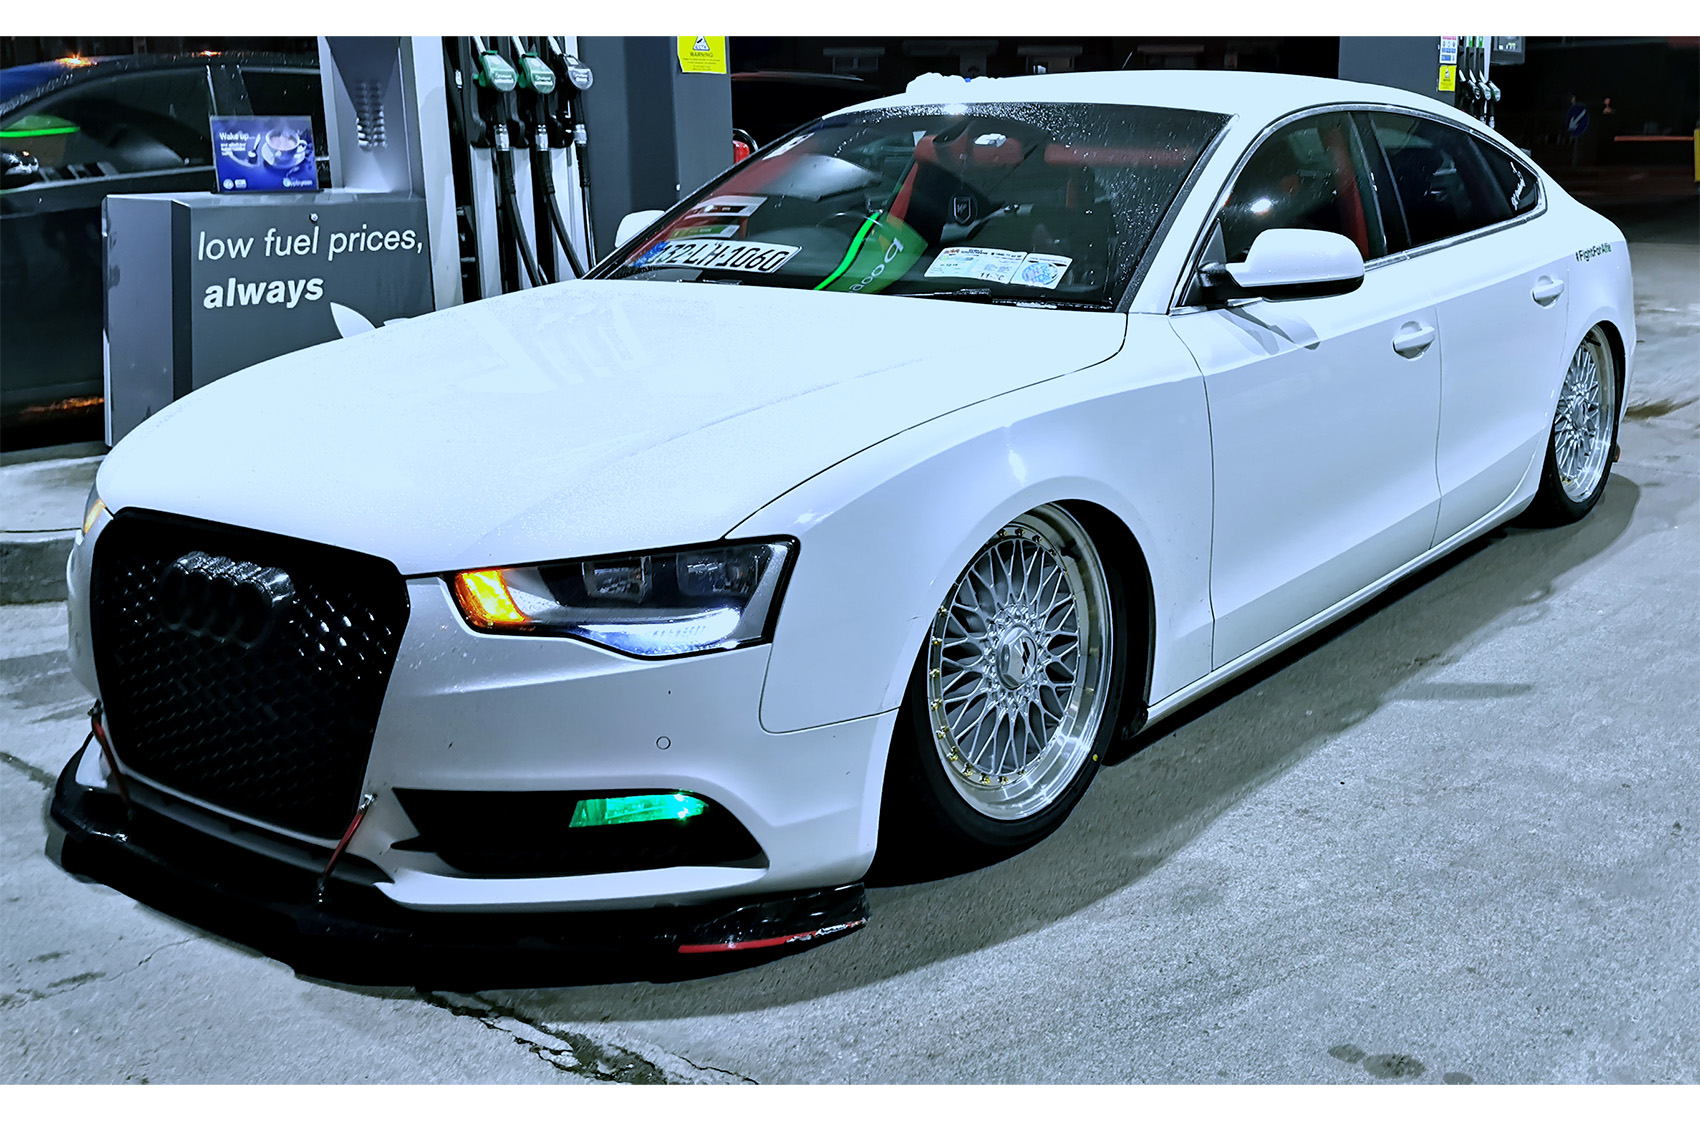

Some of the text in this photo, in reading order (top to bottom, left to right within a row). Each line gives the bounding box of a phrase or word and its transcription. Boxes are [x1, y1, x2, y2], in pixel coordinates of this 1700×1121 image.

[219, 131, 239, 141] Wake
[198, 223, 423, 261] low fuel prices,
[203, 277, 324, 309] always
